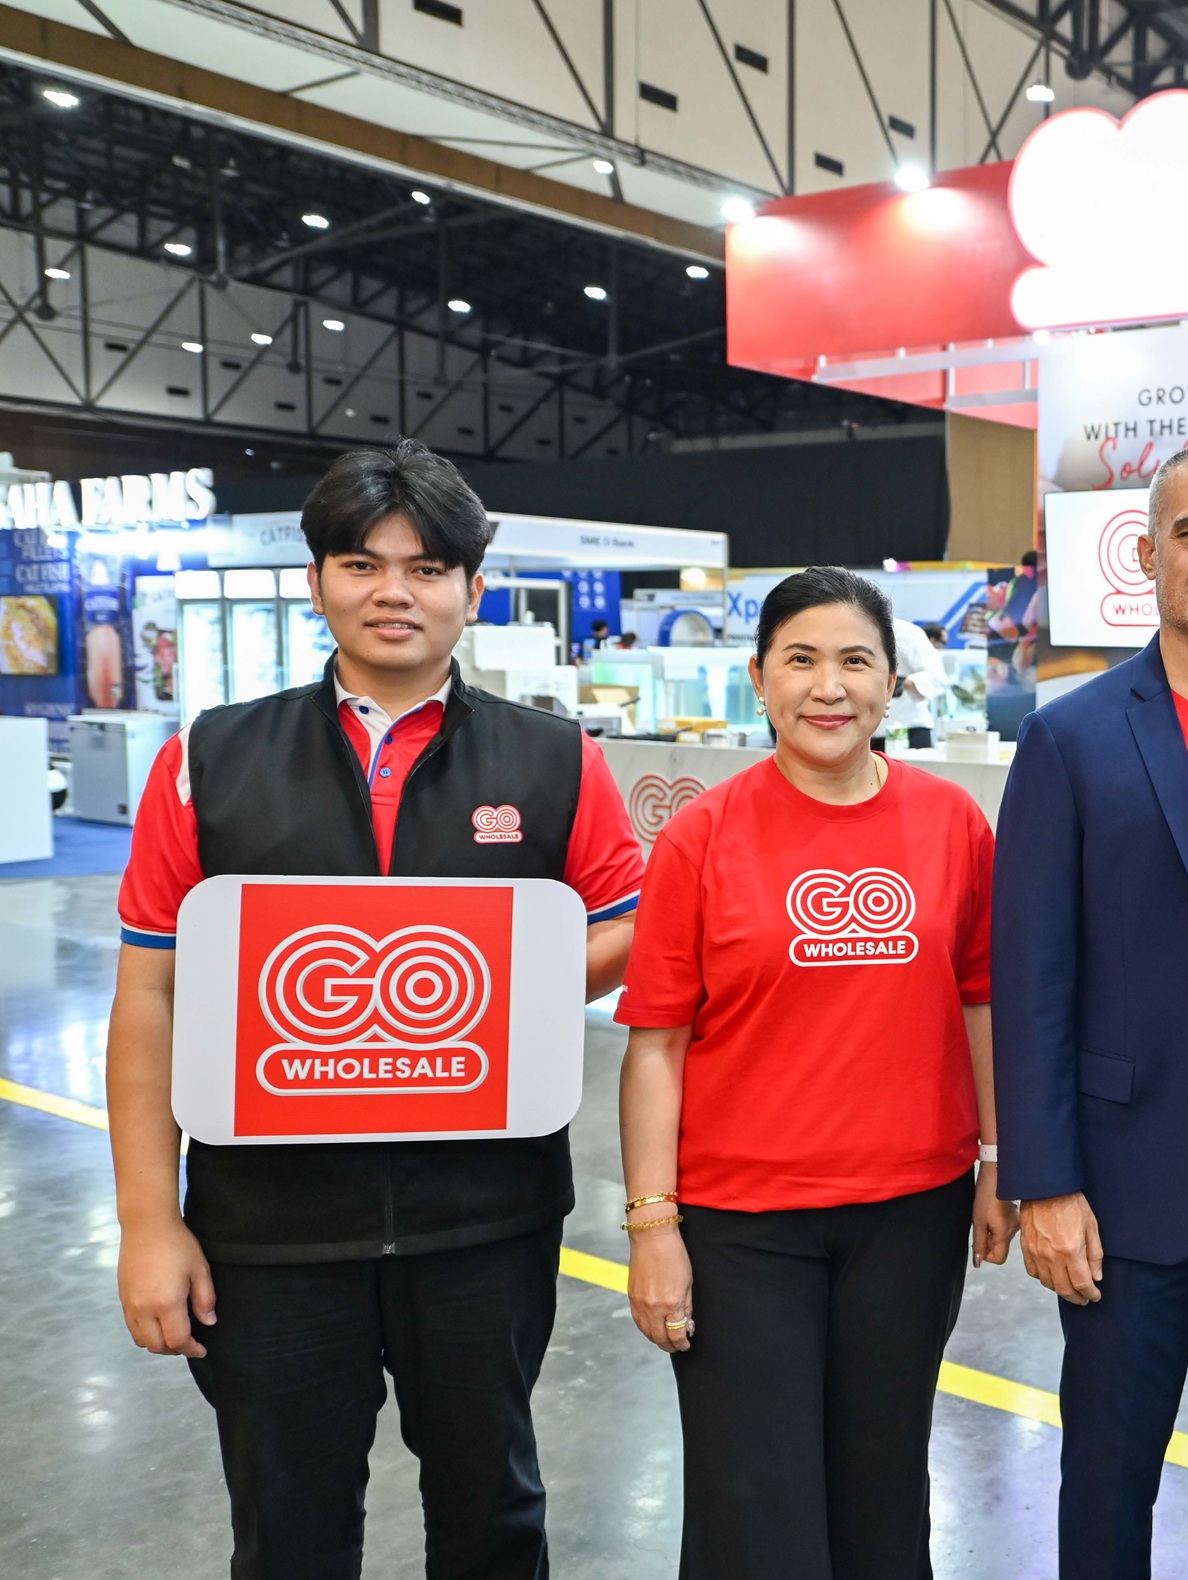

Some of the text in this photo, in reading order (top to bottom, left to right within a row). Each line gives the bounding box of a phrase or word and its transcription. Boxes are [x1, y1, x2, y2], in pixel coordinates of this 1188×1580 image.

[1084, 421, 1138, 441] WITH
[1147, 417, 1186, 437] THE
[80, 467, 216, 526] FARMS
[260, 526, 307, 547] CATFIS
[728, 592, 759, 624] Xp
[471, 804, 521, 833] GO
[479, 833, 519, 841] WHOLESALE
[786, 867, 916, 940] GO
[803, 940, 906, 958] WHOLESALE
[258, 924, 492, 1051] GO
[280, 1056, 466, 1081] WHOLESALE
